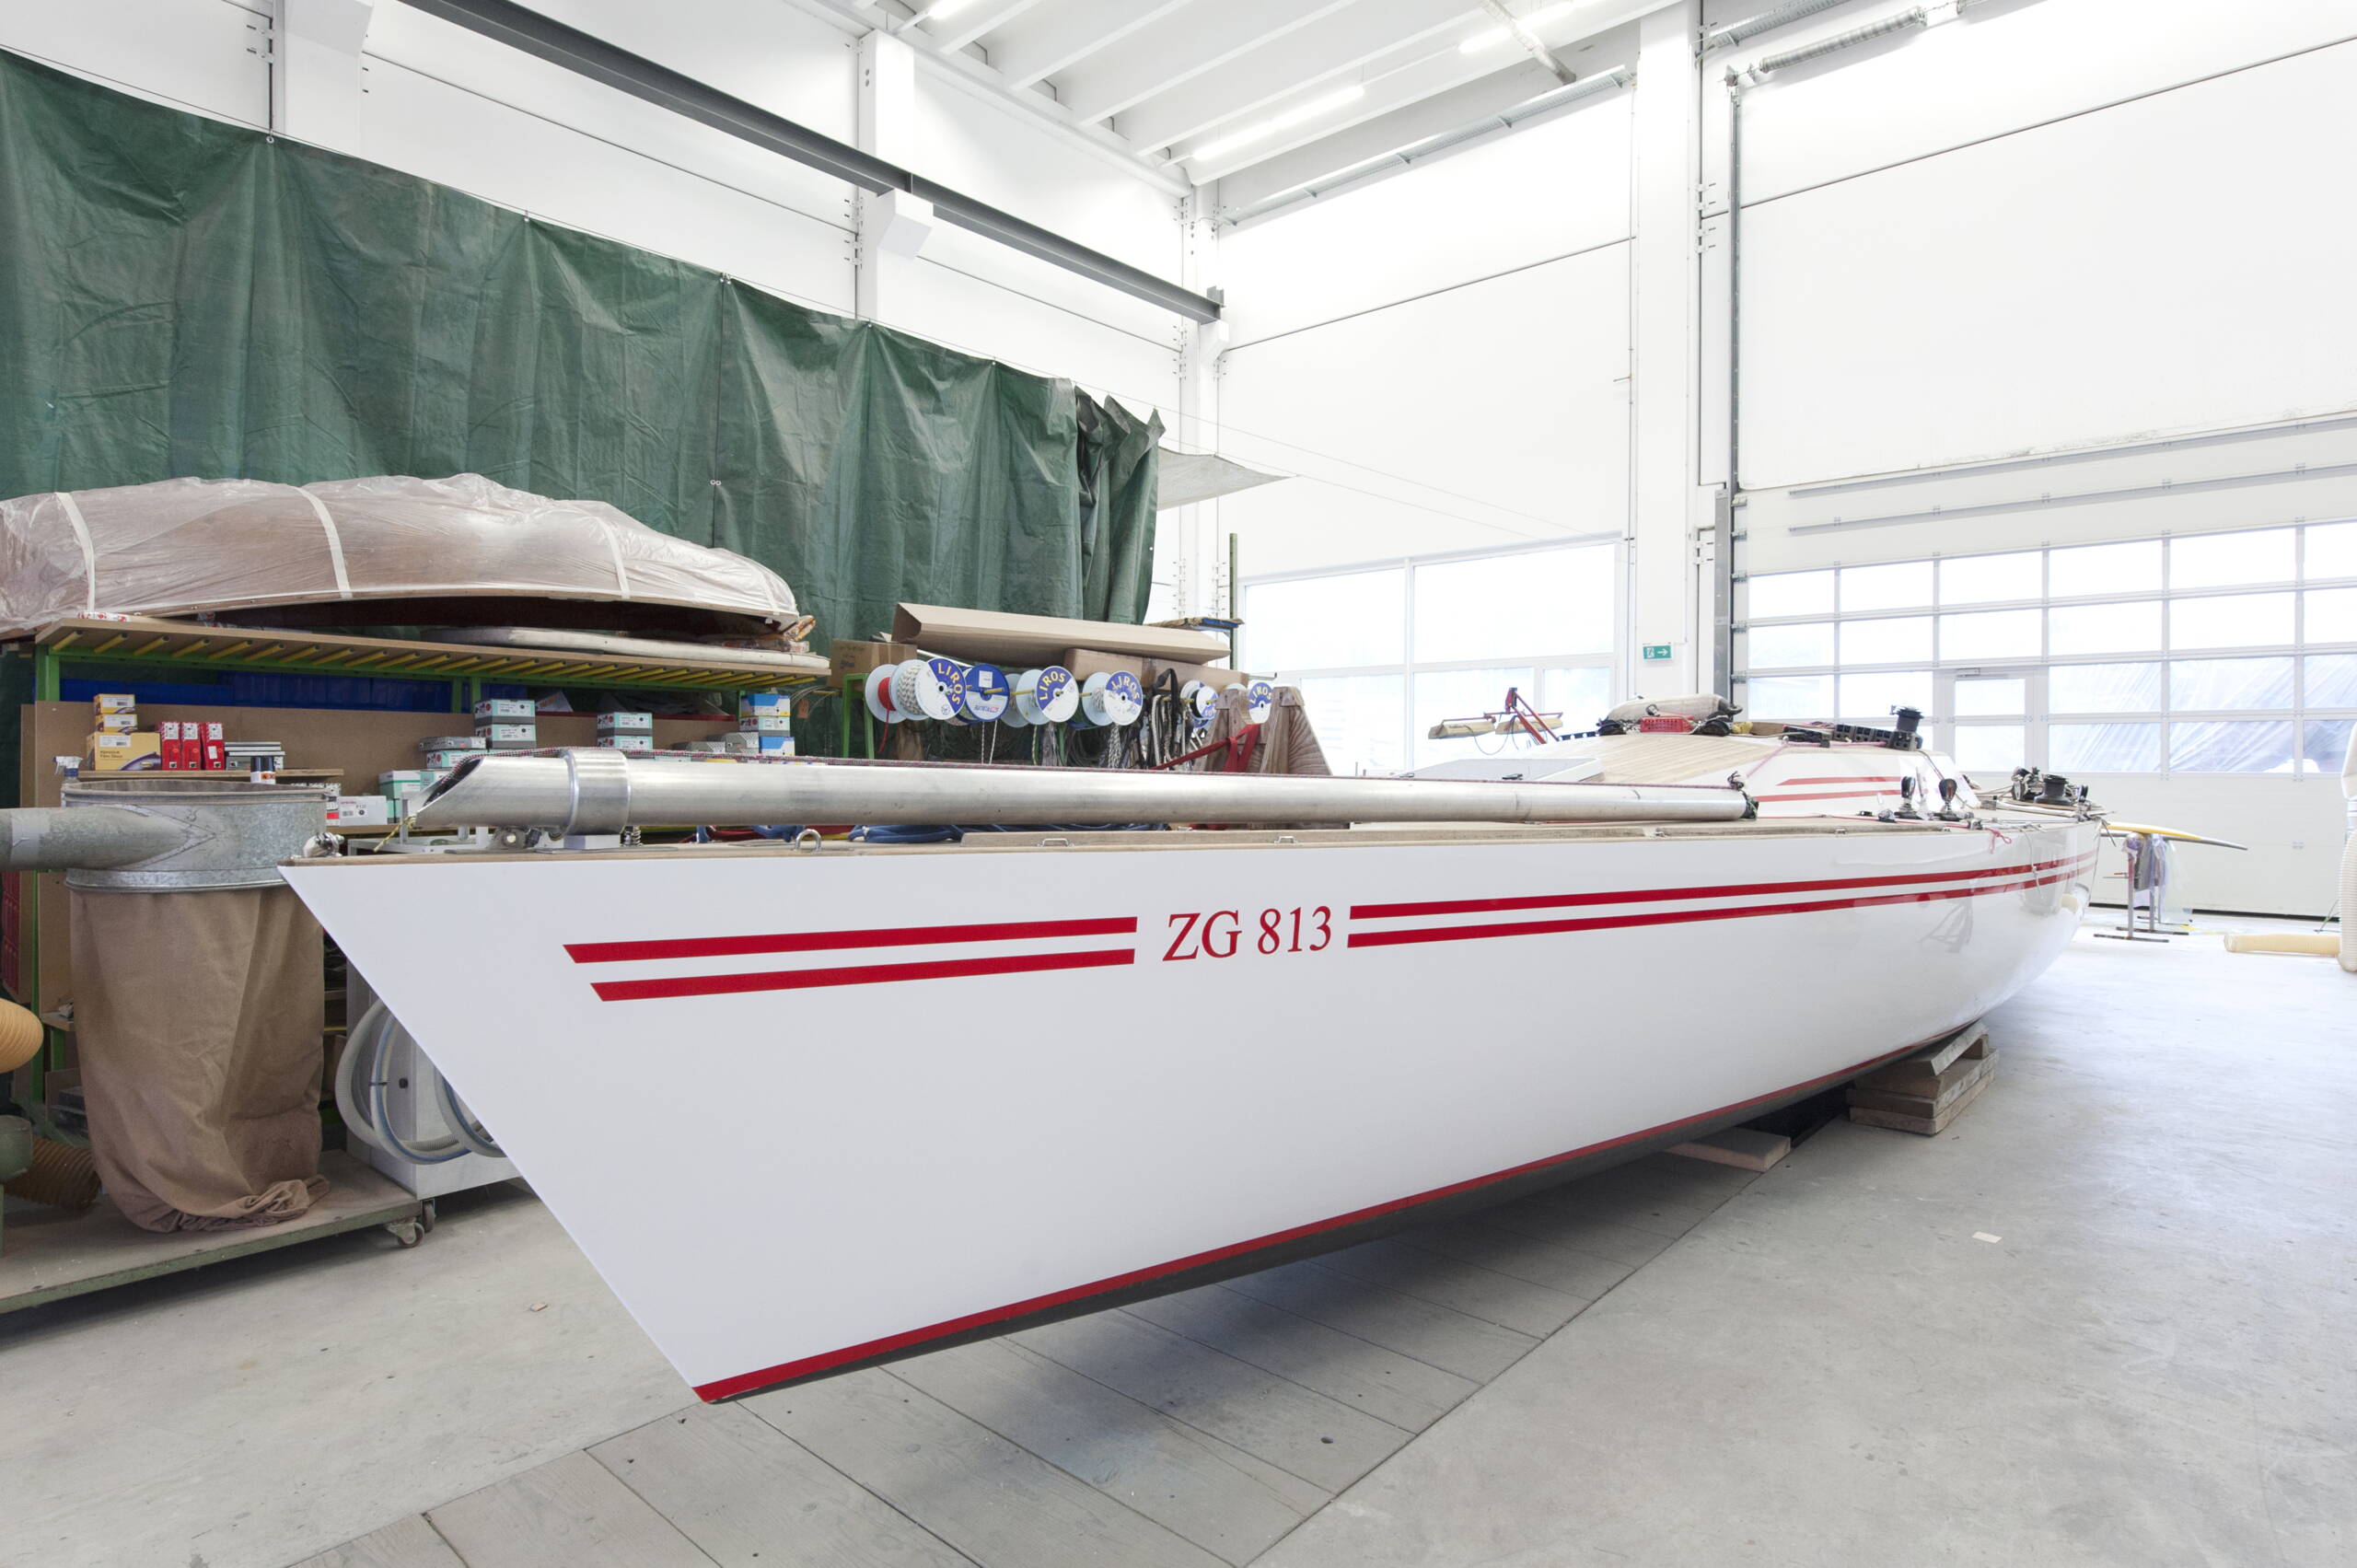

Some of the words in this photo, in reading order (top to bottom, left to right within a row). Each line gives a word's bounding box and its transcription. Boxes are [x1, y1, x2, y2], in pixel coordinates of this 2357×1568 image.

[938, 662, 963, 704] LIROS
[1039, 670, 1065, 701] LIROS
[1111, 676, 1140, 700] LIROS
[1248, 686, 1272, 704] LIROS
[1162, 910, 1242, 961] ZG
[1258, 906, 1331, 955] 813
